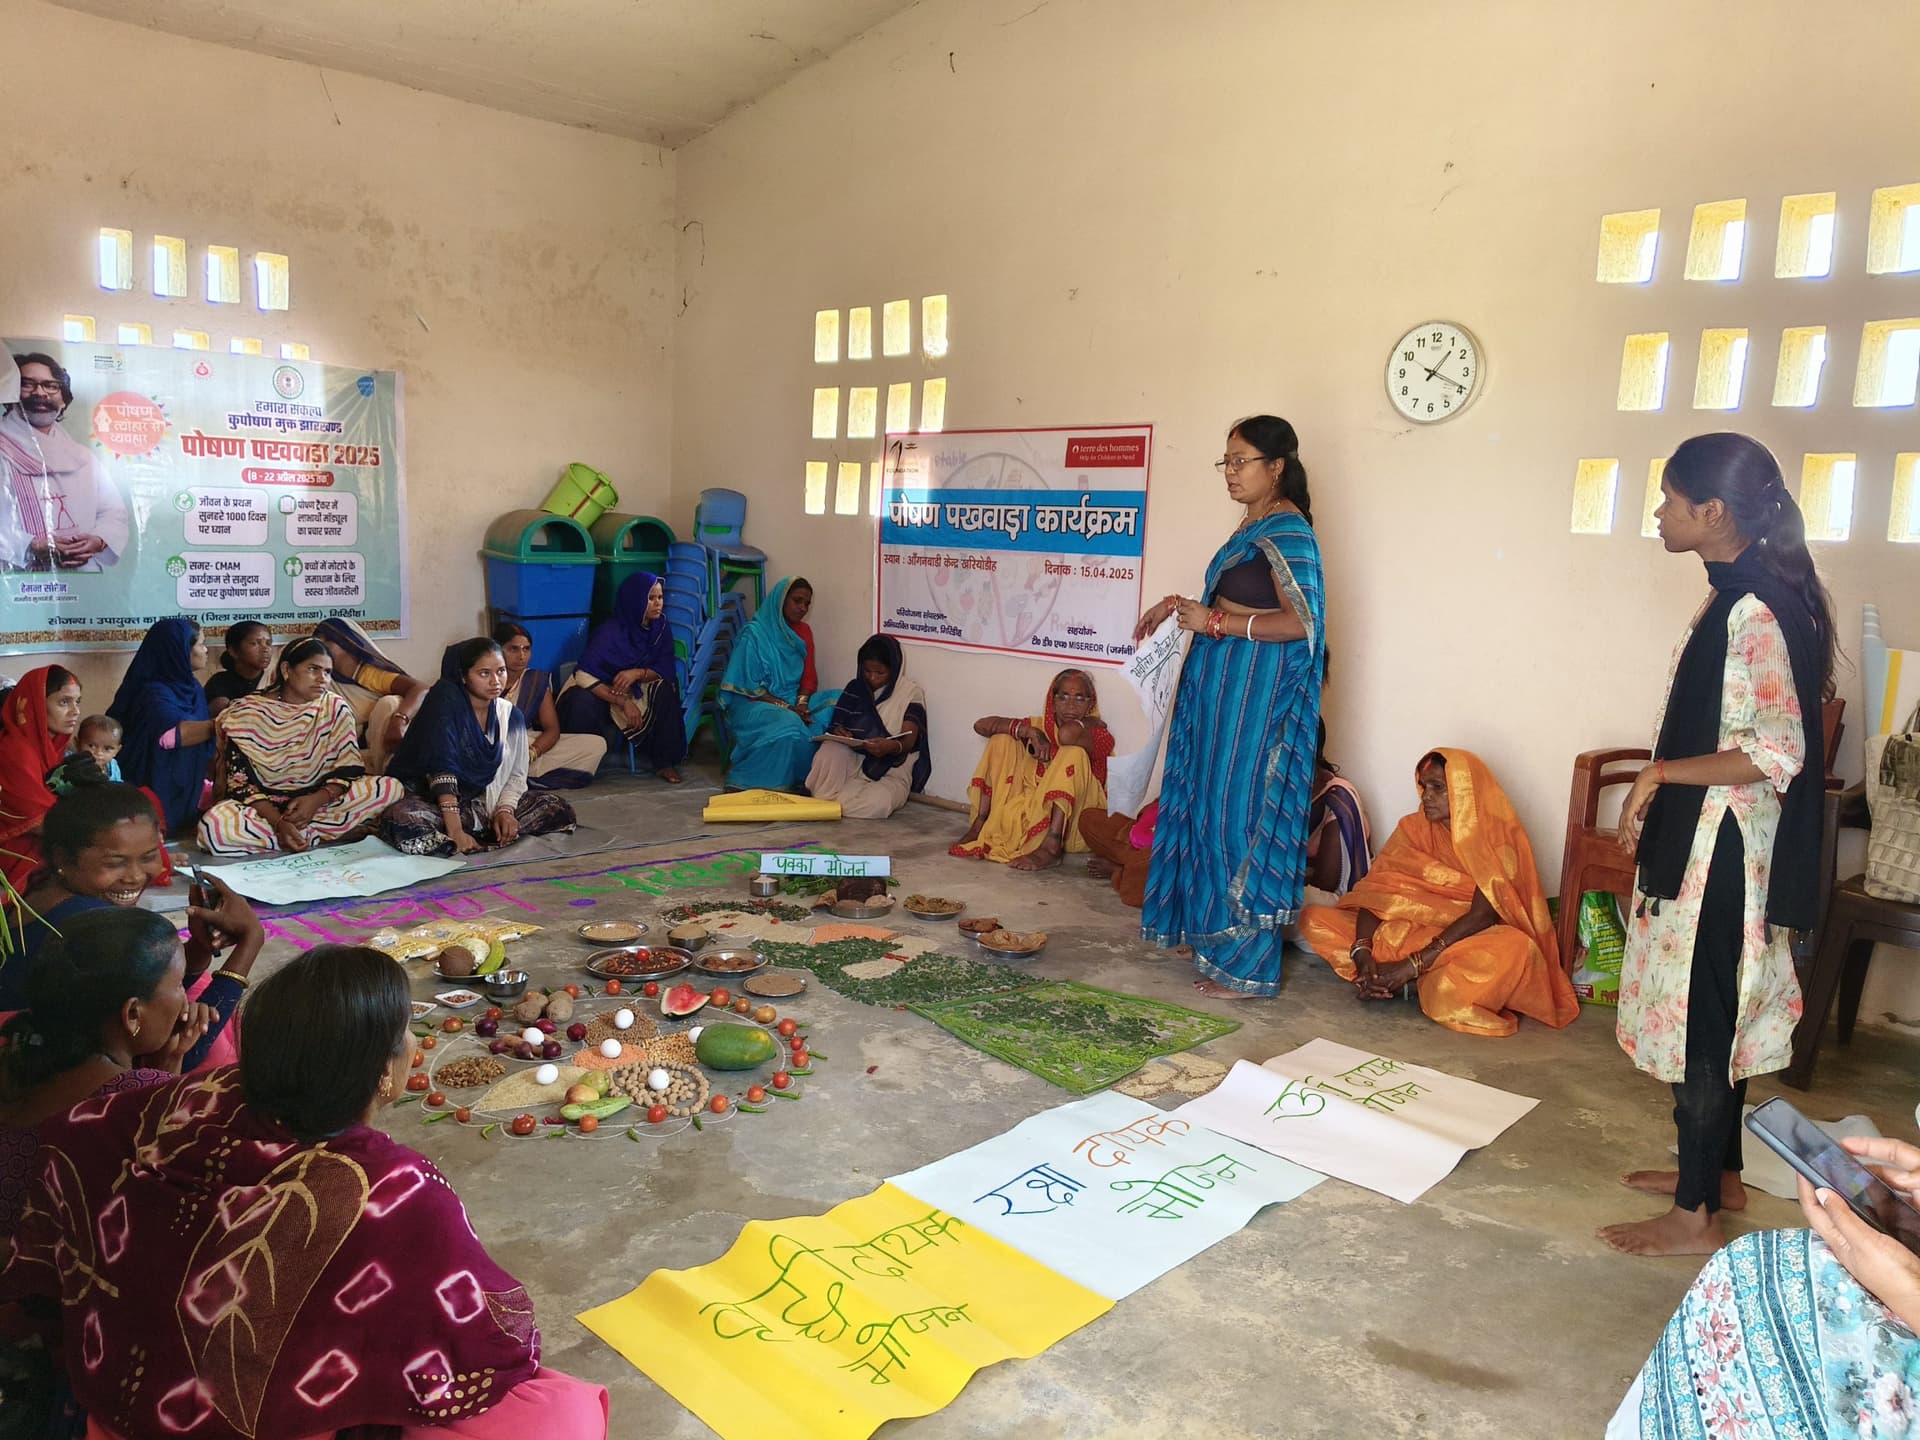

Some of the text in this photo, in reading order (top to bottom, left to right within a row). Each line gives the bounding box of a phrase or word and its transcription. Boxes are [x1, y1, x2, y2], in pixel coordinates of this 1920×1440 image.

[1416, 337, 1426, 348] 11
[1432, 332, 1443, 343] 12
[1404, 351, 1414, 361] 10
[1459, 349, 1467, 360] 2
[1399, 368, 1406, 378] 9
[1462, 366, 1469, 377] 3
[1401, 385, 1408, 396] 8
[1456, 385, 1463, 395] 4
[255, 401, 287, 415] हमारा
[1412, 398, 1419, 408] 7
[1427, 402, 1434, 413] 6
[1443, 400, 1450, 408] 5
[228, 413, 343, 433] कुपोषण मुक्त झारखण्ड
[181, 430, 380, 468] पोषण पखवाड़ा 2025
[1080, 443, 1139, 453] terre des hommes
[199, 496, 251, 508] जीवन के प्रथम
[199, 511, 267, 522] सुनहरे 1000 दिवस
[889, 492, 1139, 541] पोषण पखवाड़ा कार्यक्रम
[198, 524, 231, 534] पर ध्यान
[297, 527, 306, 535] का
[215, 562, 241, 571] CMAM
[348, 561, 356, 570] के
[884, 554, 900, 565] स्थान
[944, 554, 959, 569] केन्द्र
[304, 575, 333, 584] समाधान
[334, 573, 341, 583] के
[1080, 566, 1134, 580] 15.04.2025
[189, 573, 259, 587] कार्यक्रम से समुदाय
[189, 588, 206, 597] स्तर
[207, 588, 218, 597] पर
[219, 586, 248, 599] कुपोषण
[97, 616, 140, 627] उपायुक्त
[143, 616, 156, 624] का
[232, 612, 261, 621] समाज
[263, 611, 295, 620] कल्याण
[1069, 641, 1104, 652] MISEREOR
[1073, 1114, 1190, 1168] दायक
[1110, 1154, 1256, 1219] भोजन
[834, 1209, 965, 1281] दायक
[837, 1304, 971, 1384] भोजन
